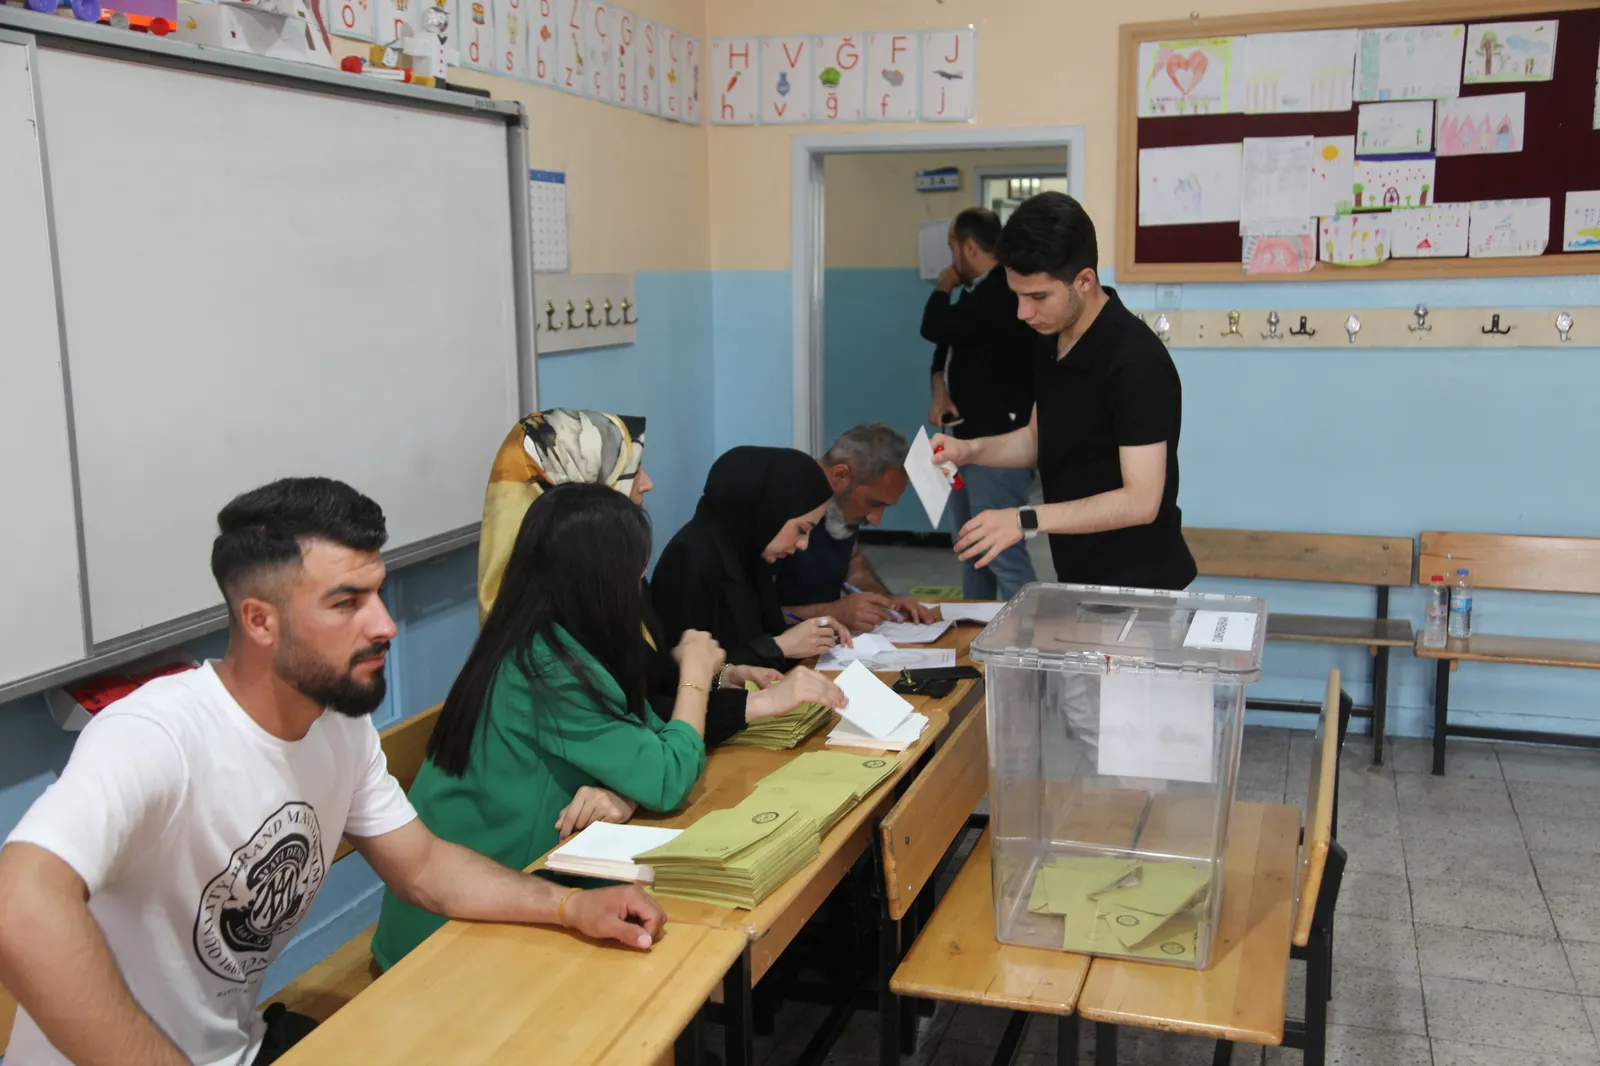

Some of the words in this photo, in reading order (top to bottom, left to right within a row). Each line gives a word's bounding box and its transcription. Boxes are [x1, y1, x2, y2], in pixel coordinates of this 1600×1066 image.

[729, 43, 749, 69] H
[836, 37, 859, 70] Ğ
[892, 36, 907, 63] F
[944, 35, 959, 63] J
[721, 94, 735, 120] h
[826, 92, 839, 120] ğ
[880, 93, 892, 117] f
[231, 818, 283, 879] BRAND
